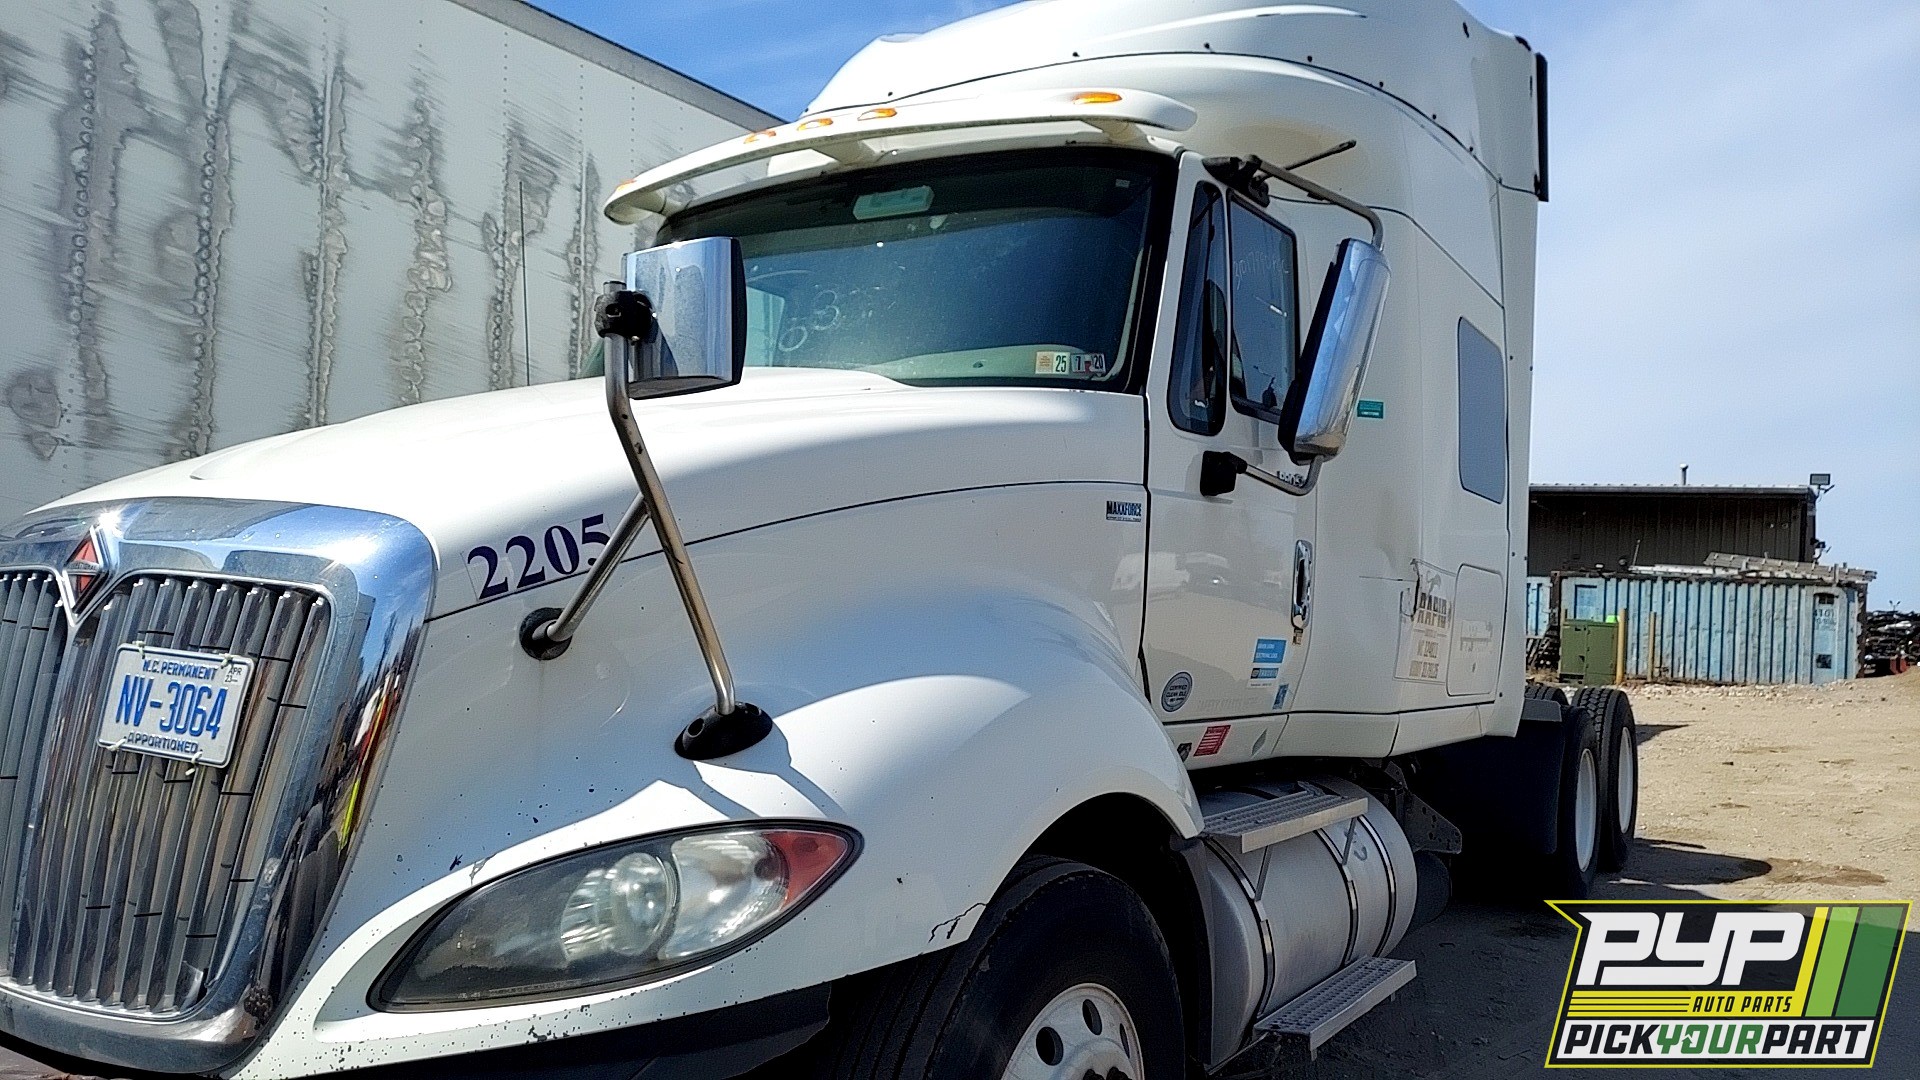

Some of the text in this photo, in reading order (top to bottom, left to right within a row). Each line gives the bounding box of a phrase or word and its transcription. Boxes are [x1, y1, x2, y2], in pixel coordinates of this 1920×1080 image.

[1055, 355, 1067, 373] 25
[1106, 501, 1142, 516] MAXXFORCE
[467, 514, 611, 600] 2205
[160, 661, 219, 681] PERMANENT
[228, 667, 242, 676] APR
[115, 673, 229, 740] NV-3064
[126, 731, 199, 754] APPORTIONED
